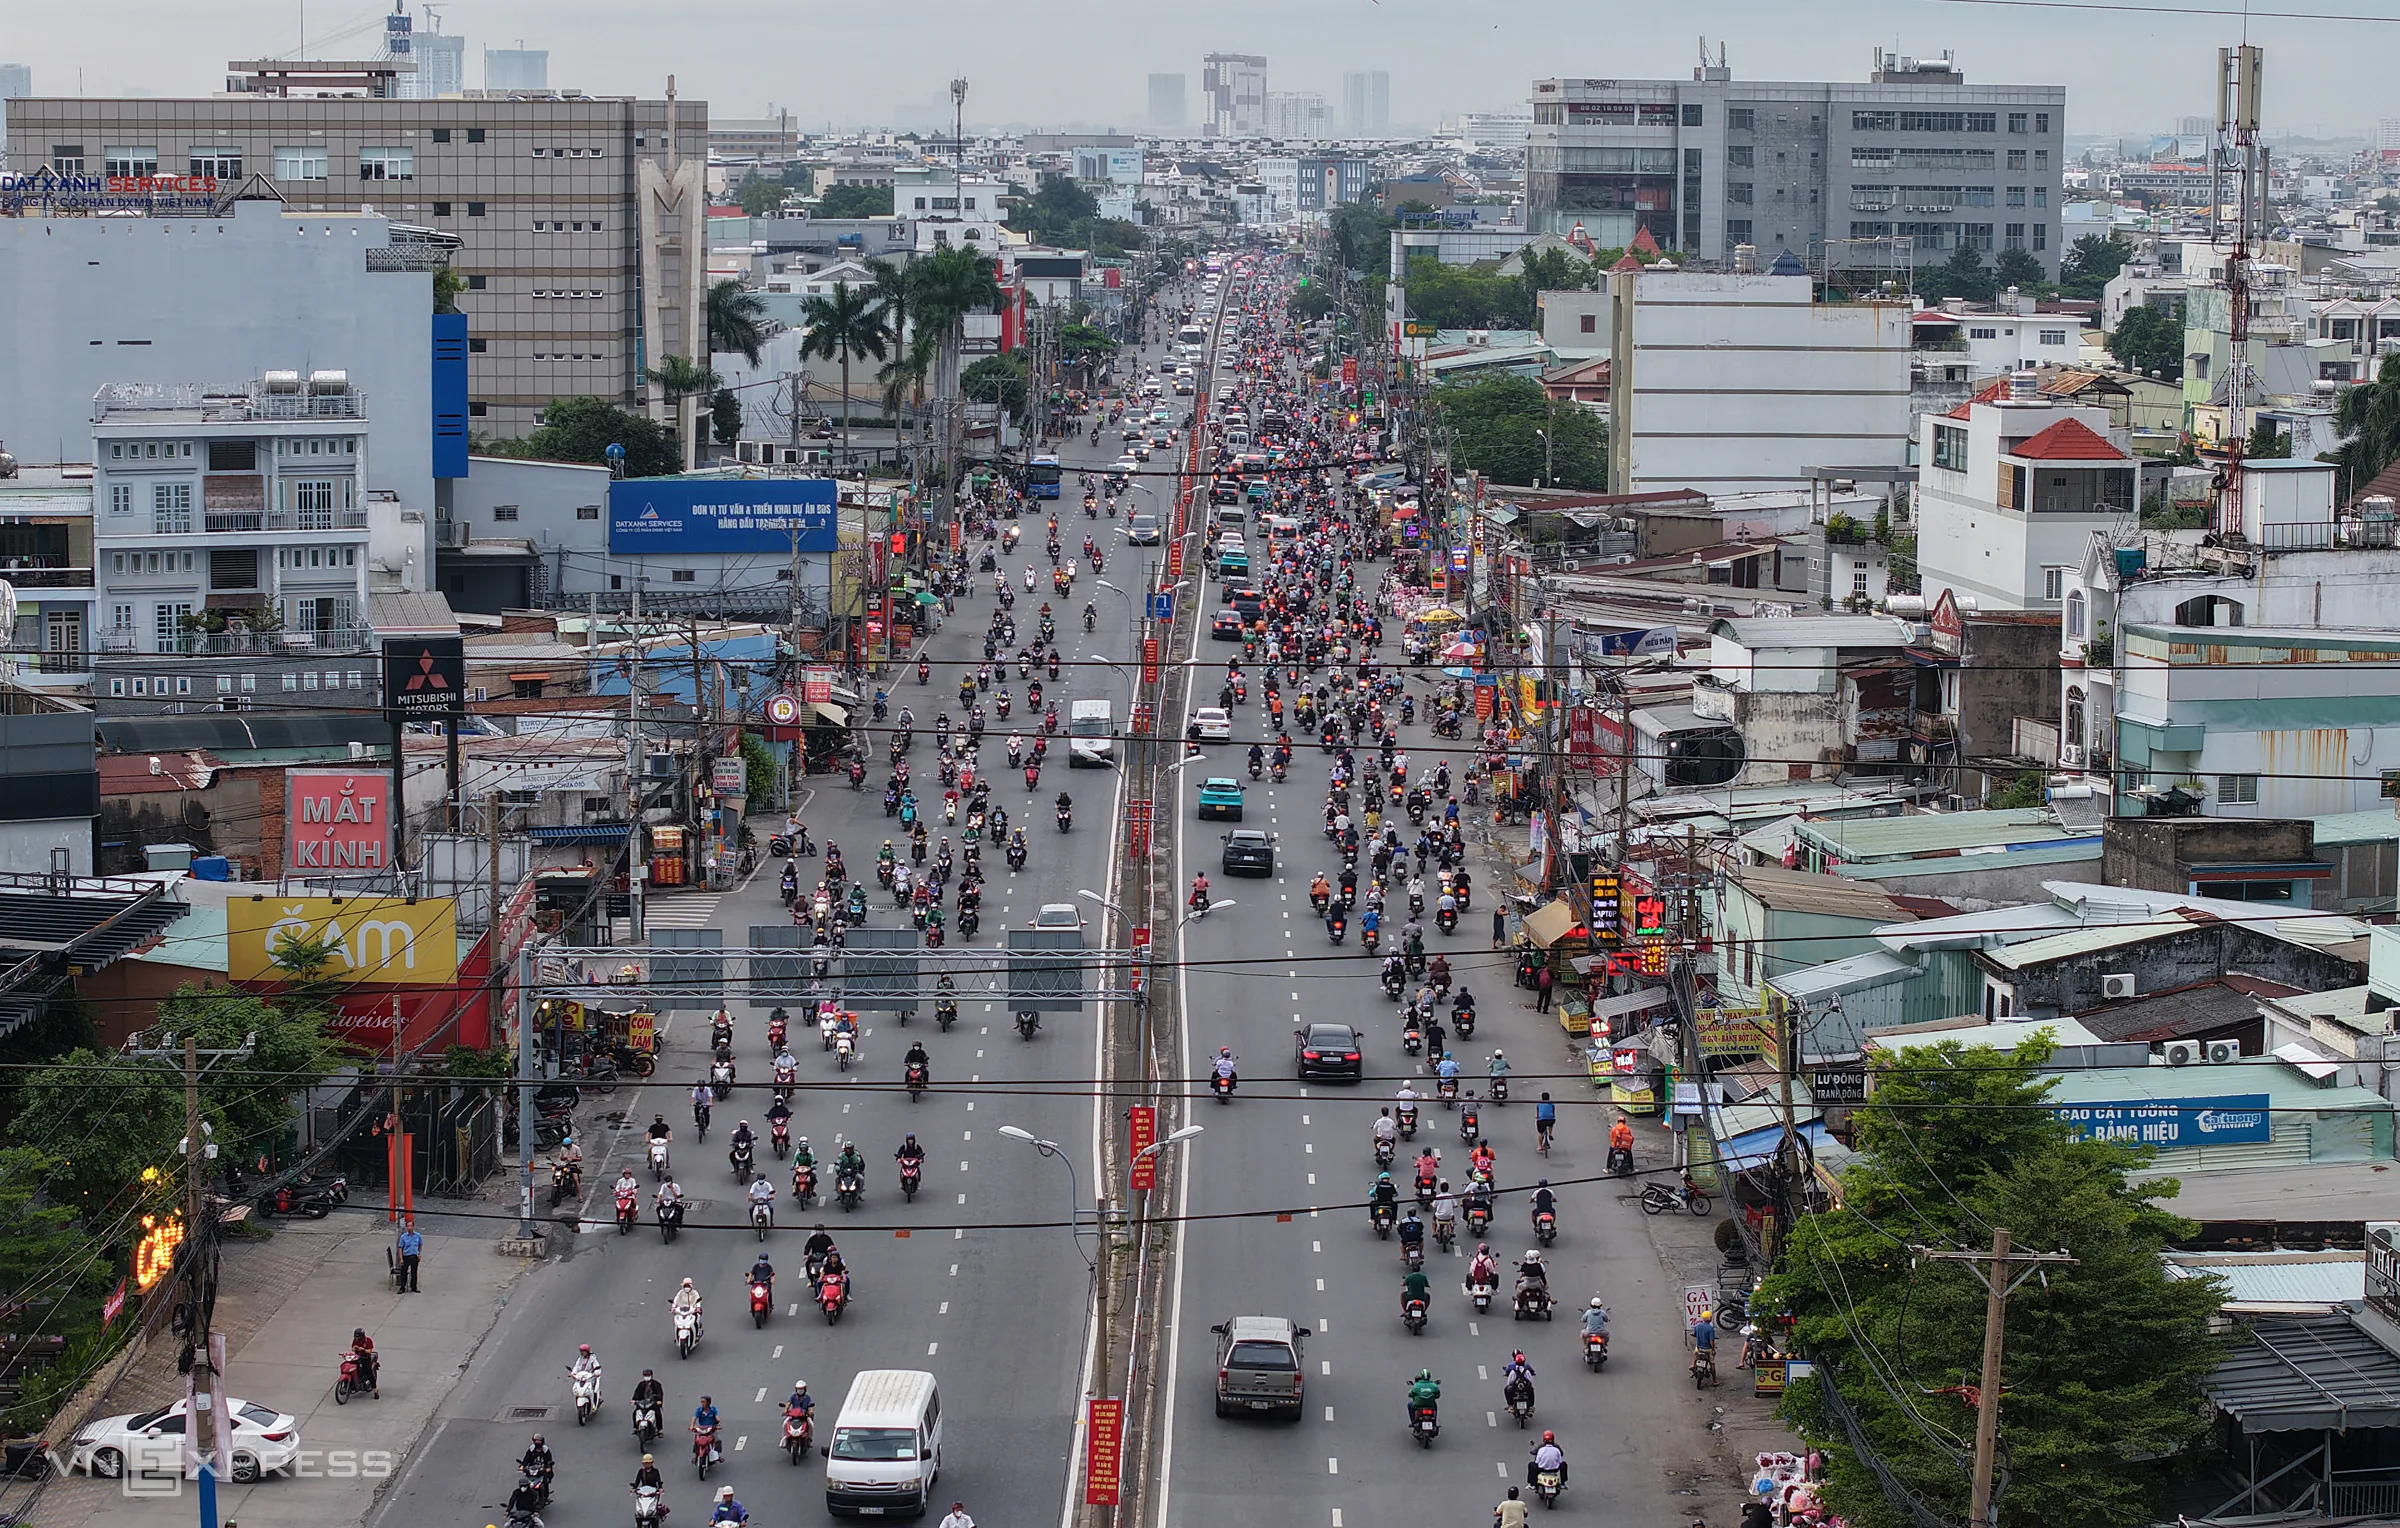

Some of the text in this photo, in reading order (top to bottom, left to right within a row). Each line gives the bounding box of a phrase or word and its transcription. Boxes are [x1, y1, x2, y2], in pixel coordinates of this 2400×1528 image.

[2, 176, 217, 192] DATXANH SERVICES
[185, 197, 213, 207] NAM
[1395, 206, 1480, 221] Sacombank
[774, 504, 791, 514] KHAI
[615, 520, 648, 528] DATXANH
[718, 517, 738, 529] HÀNG
[398, 692, 457, 704] MITSUBISHI
[777, 703, 790, 716] 15
[520, 720, 541, 728] EURO
[303, 777, 377, 823] MẮT
[297, 826, 381, 867] KÍNH
[631, 1015, 653, 1029] CƠM
[631, 1031, 651, 1048] TẤM
[1816, 1089, 1841, 1100] TRANH
[2095, 1119, 2139, 1142] BẢNG
[2143, 1121, 2179, 1145] HIỆU
[1686, 1288, 1709, 1303] GÀ
